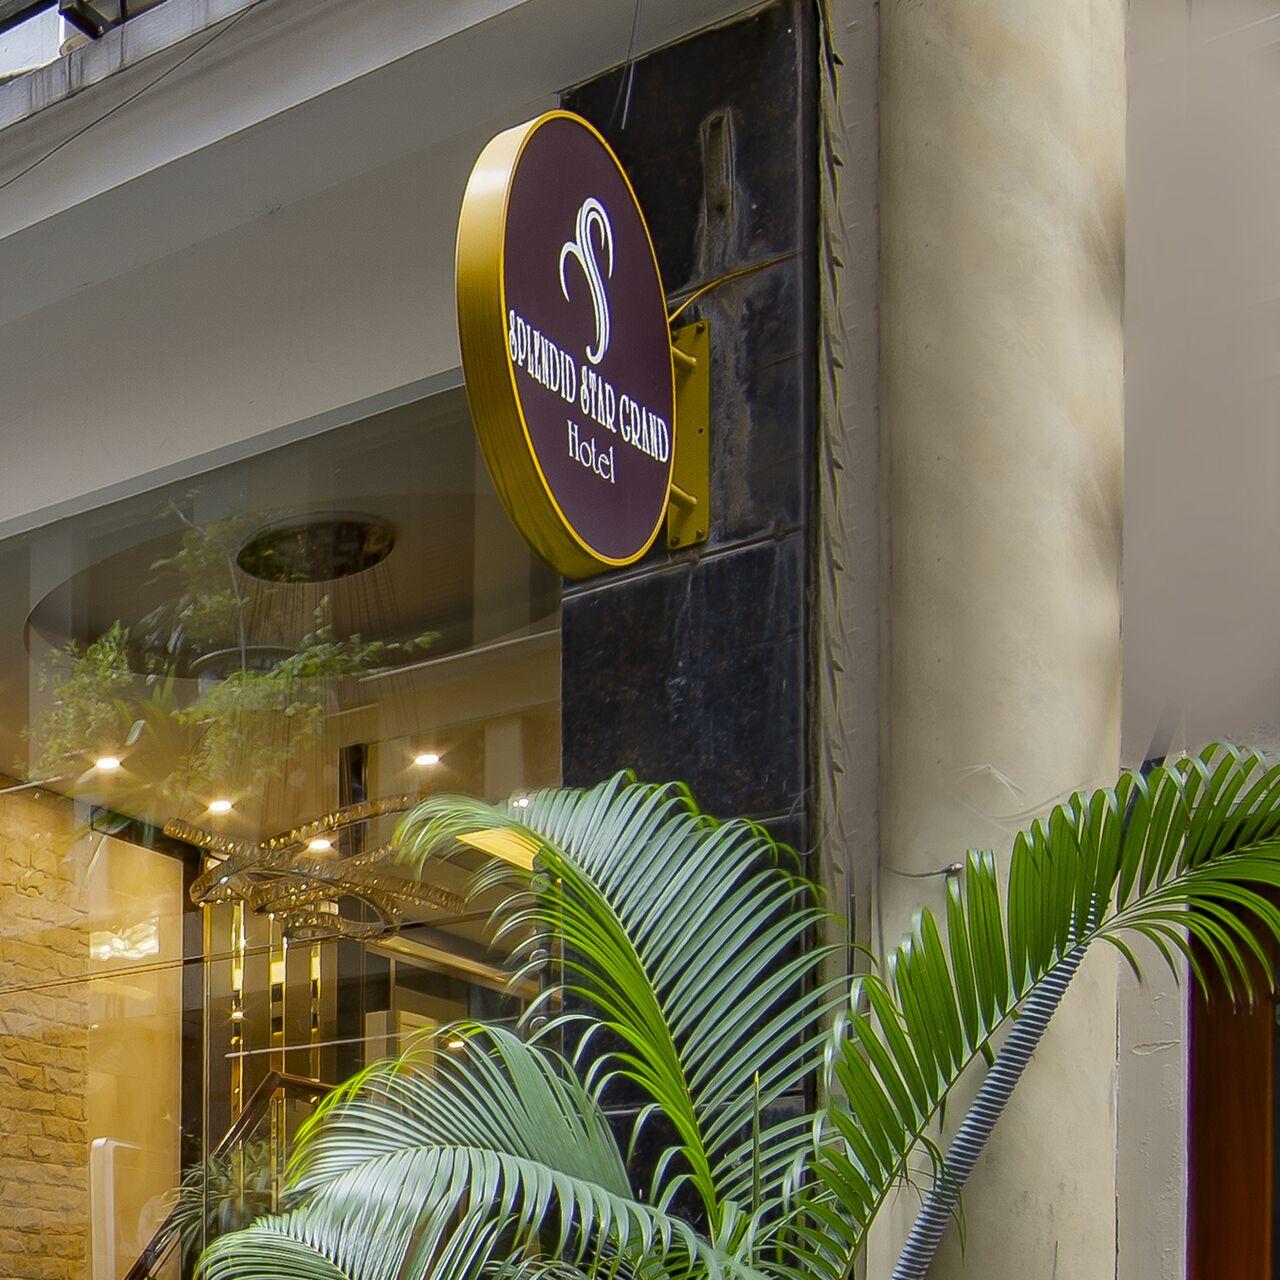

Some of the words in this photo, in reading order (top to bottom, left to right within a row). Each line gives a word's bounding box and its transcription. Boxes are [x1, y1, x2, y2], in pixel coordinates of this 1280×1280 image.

[509, 310, 577, 404] SPLENDID
[580, 365, 617, 434] STAR
[619, 394, 669, 463] GRAND
[567, 419, 616, 484] Hotel
